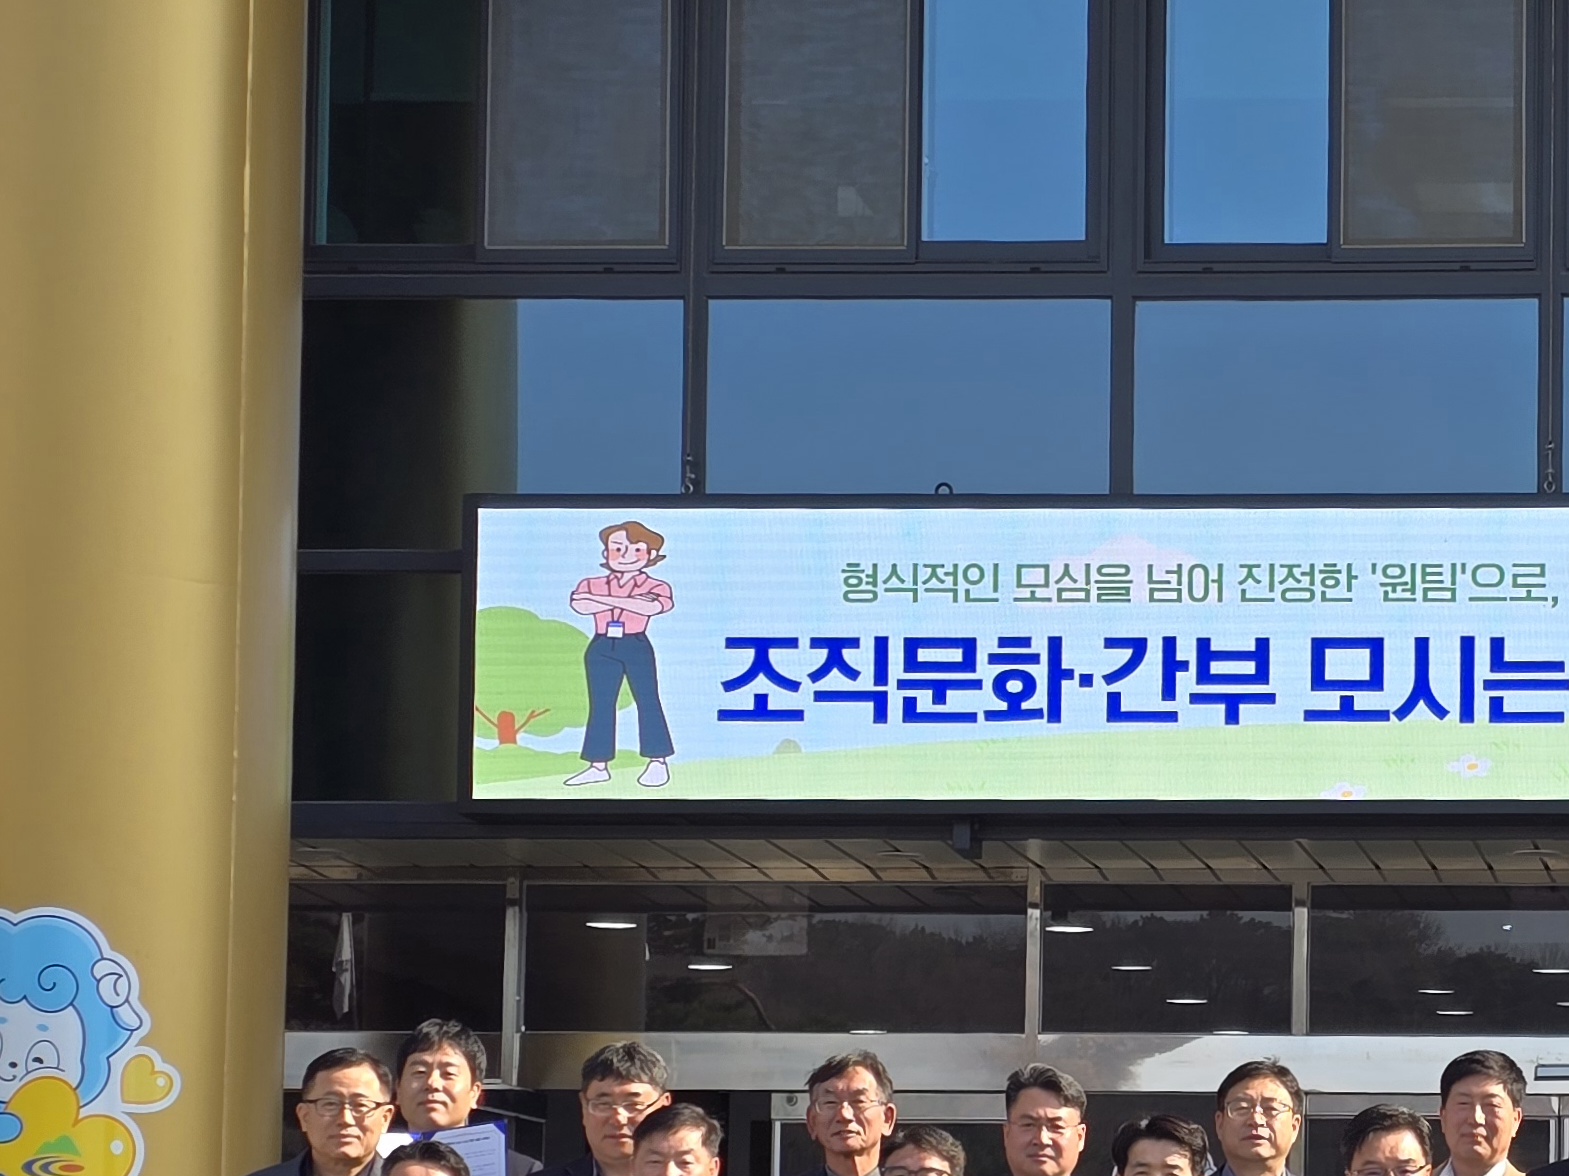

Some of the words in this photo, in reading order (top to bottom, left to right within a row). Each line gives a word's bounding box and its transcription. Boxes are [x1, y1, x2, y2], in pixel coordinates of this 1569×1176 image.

[841, 563, 1000, 604] 형식적인
[1013, 563, 1134, 604] 모심을
[1148, 563, 1224, 604] 넘어
[1238, 563, 1359, 603] 진정한
[1371, 562, 1560, 608] '원팀'으로,
[717, 634, 1276, 725] 조직문화·간부
[1303, 634, 1569, 723] 모시는
